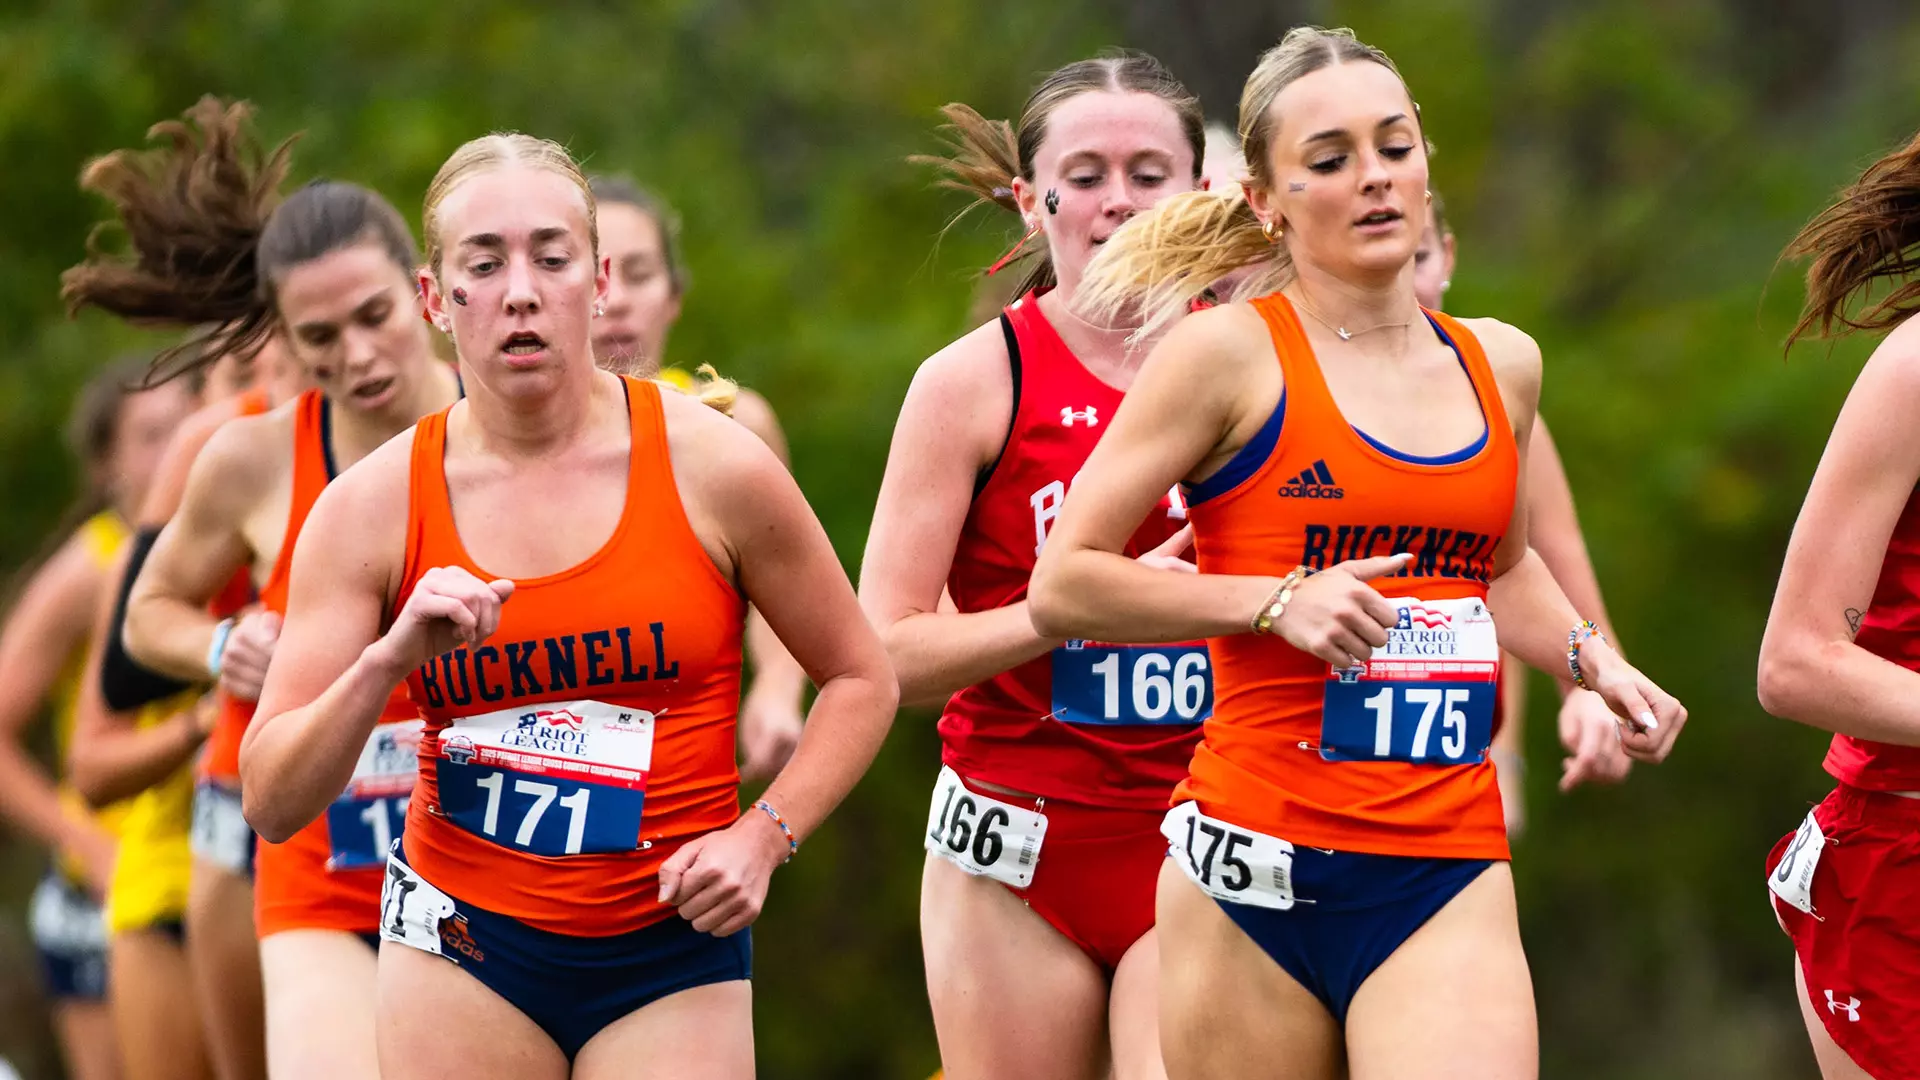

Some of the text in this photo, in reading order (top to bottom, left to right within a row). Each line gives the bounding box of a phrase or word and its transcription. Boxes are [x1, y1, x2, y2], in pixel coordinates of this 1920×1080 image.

[1278, 484, 1345, 499] adidas
[420, 621, 680, 709] BUCKNELL
[1386, 643, 1459, 655] LEAGUE
[1387, 630, 1458, 643] PATRIOT
[1091, 651, 1208, 720] 166
[500, 733, 588, 757] LEAGUE
[1364, 686, 1471, 759] 175
[476, 770, 592, 855] 171
[930, 784, 1010, 867] 166
[1186, 815, 1254, 892] 175
